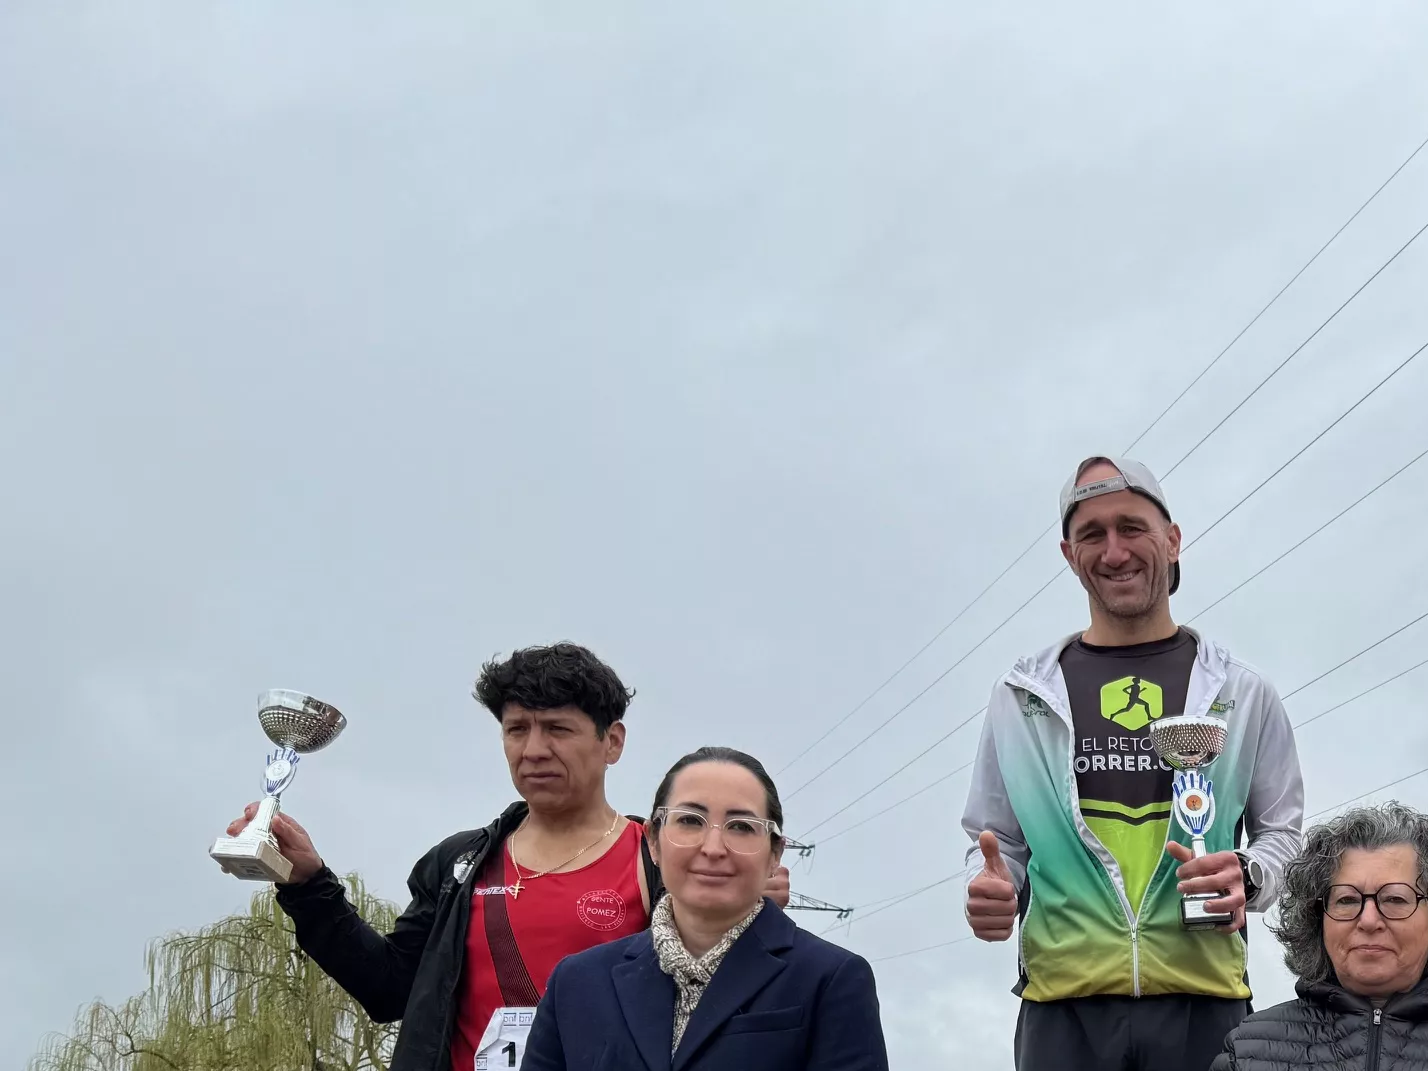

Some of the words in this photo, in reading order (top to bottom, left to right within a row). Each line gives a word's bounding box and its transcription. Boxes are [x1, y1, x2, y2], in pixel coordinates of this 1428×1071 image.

[1083, 737, 1102, 751] EL
[1108, 737, 1153, 751] RETO
[1074, 754, 1172, 773] ORRER.C
[587, 907, 617, 918] POMEZ
